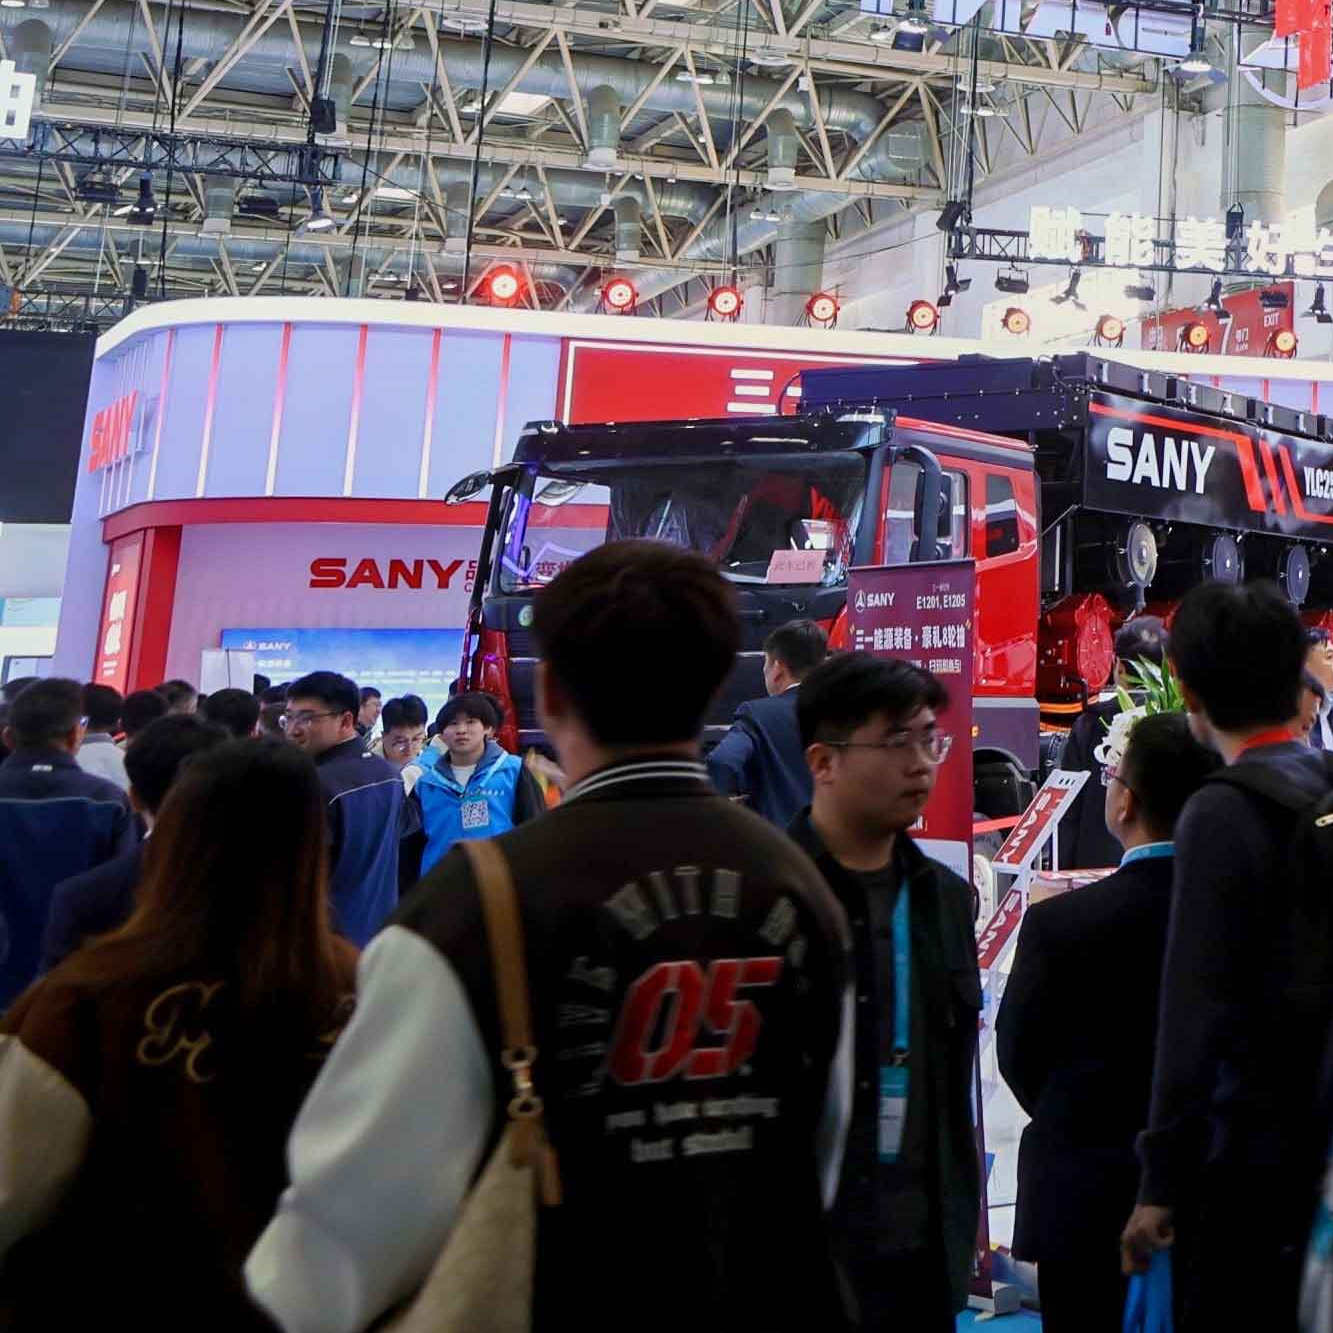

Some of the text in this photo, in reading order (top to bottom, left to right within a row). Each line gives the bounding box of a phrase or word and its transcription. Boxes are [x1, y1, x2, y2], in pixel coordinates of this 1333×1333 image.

[1263, 313, 1279, 328] EXIT
[88, 389, 138, 474] SANY
[1106, 427, 1216, 495] SANY
[309, 557, 465, 589] SANY
[867, 592, 895, 607] SANY
[1001, 791, 1052, 864] SANY
[606, 955, 785, 1087] 05
